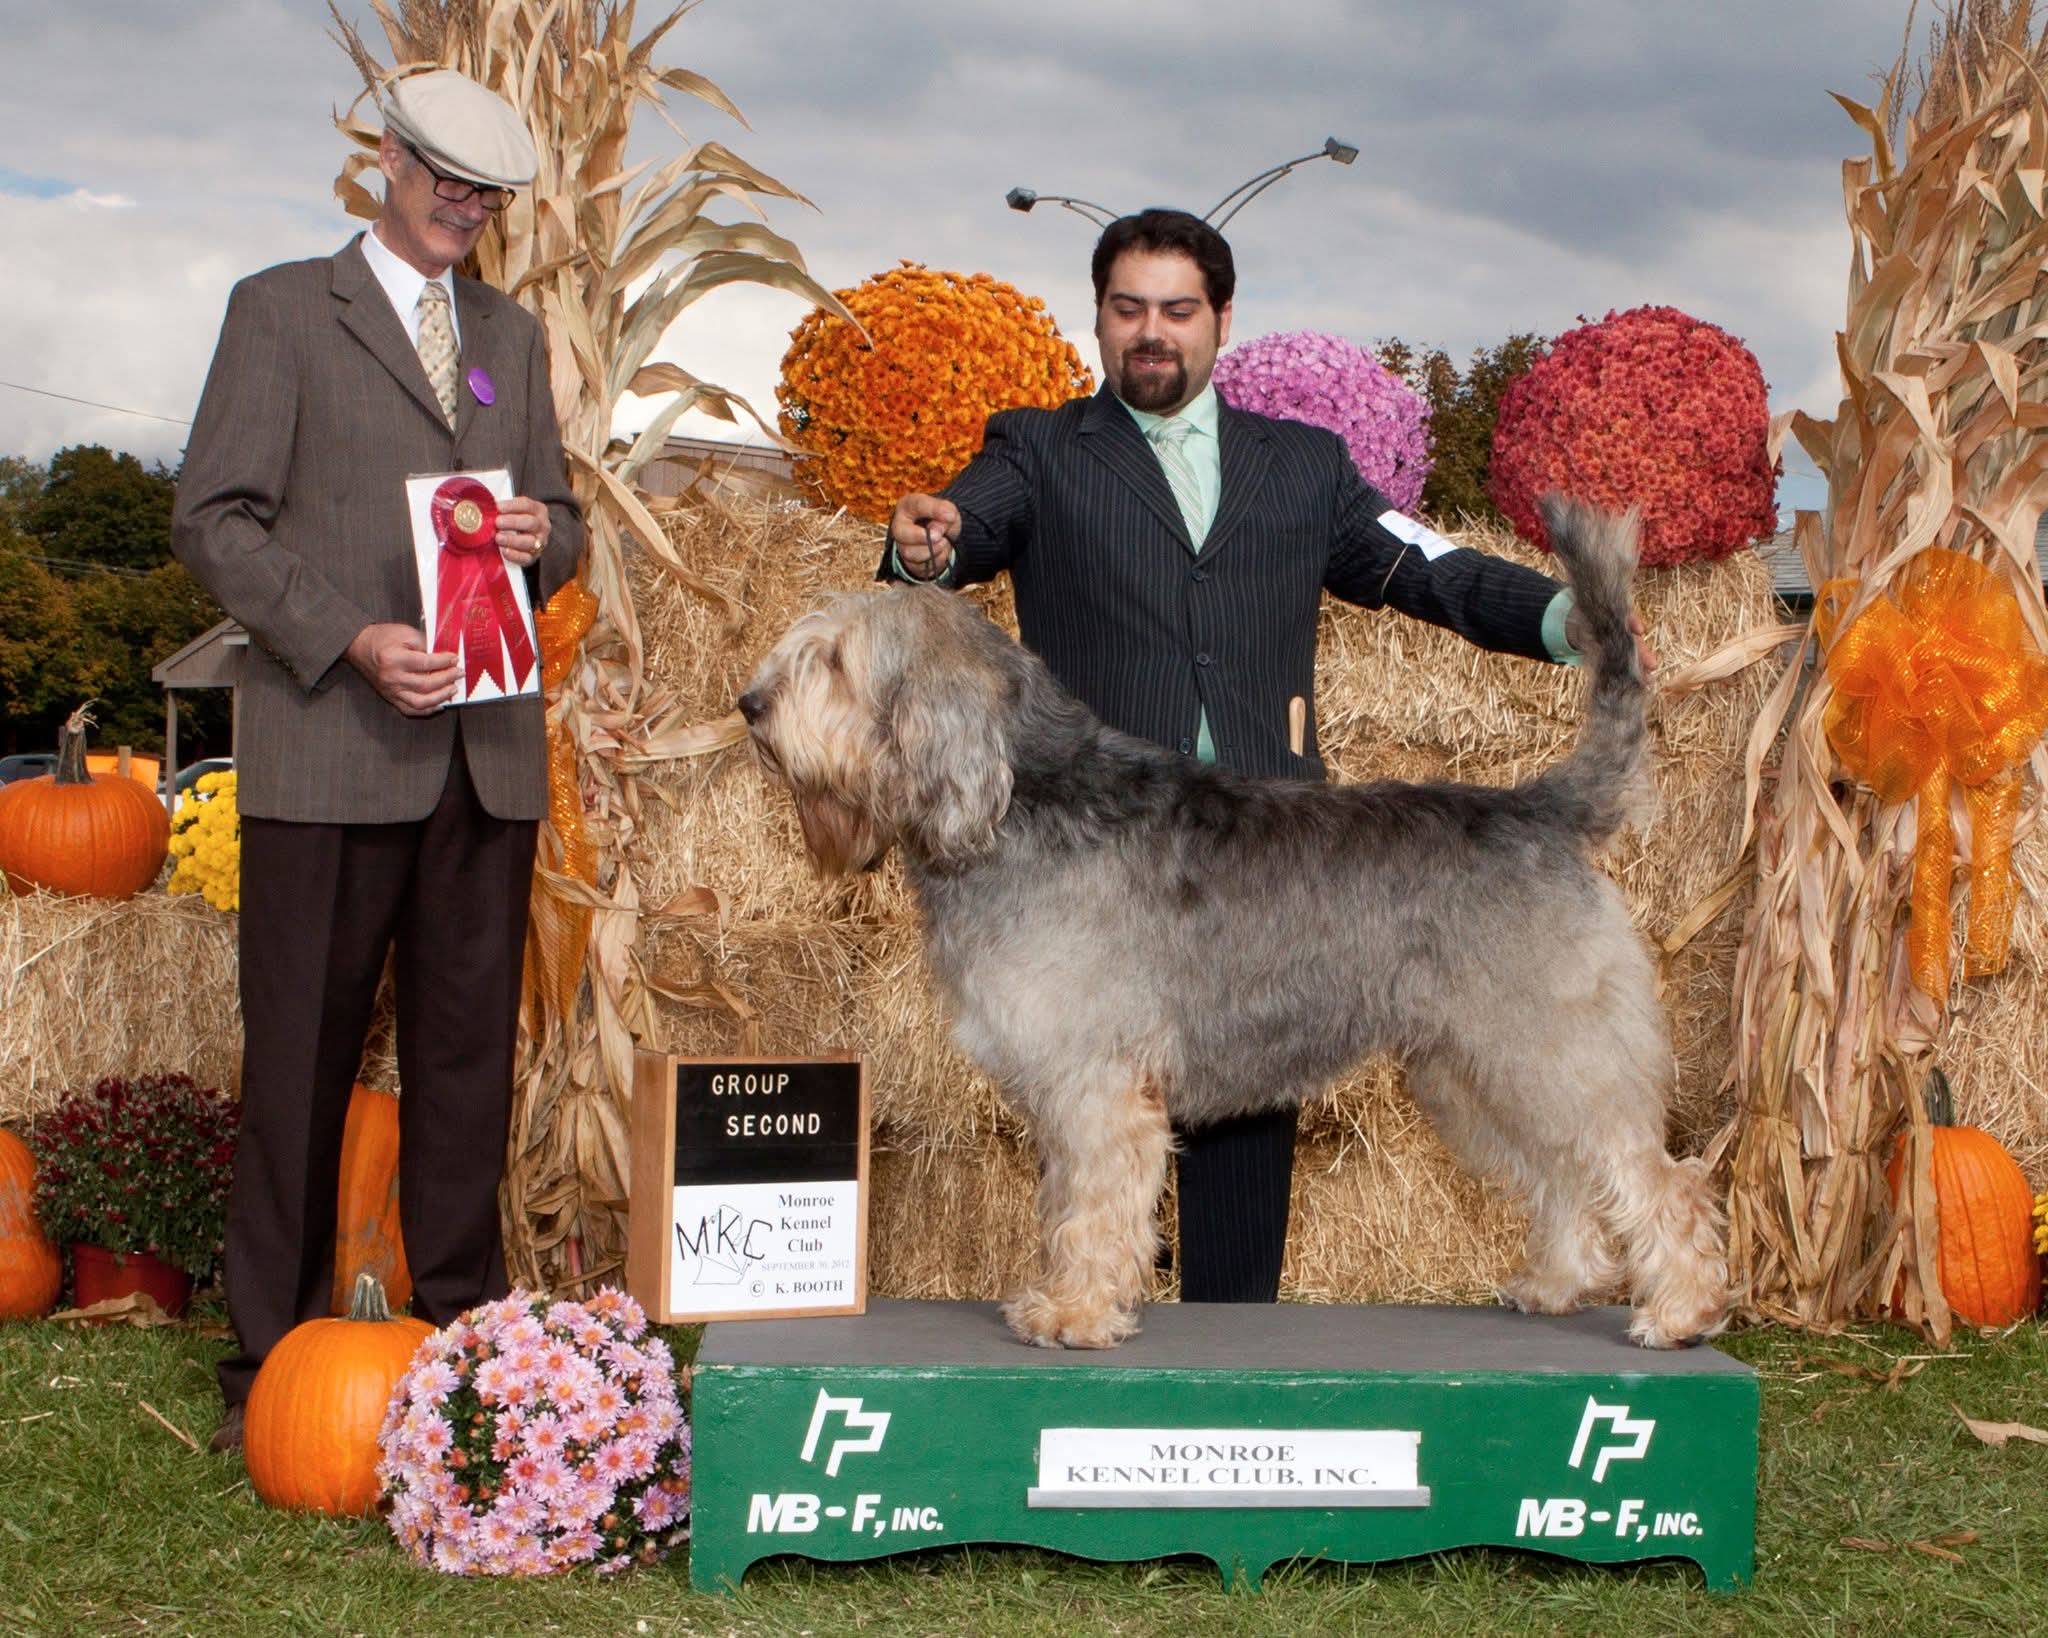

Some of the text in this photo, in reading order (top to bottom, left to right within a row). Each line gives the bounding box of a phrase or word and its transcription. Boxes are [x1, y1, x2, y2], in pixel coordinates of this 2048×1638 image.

[712, 1074, 790, 1095] GROUP
[726, 1113, 821, 1136] SECOND
[778, 1194, 835, 1208] Monroe
[780, 1216, 832, 1231] Kennel
[675, 1208, 773, 1261] MKC
[787, 1238, 823, 1253] Club
[776, 1282, 790, 1294] K.
[793, 1279, 844, 1293] BOOTH
[1150, 1444, 1295, 1462] MONROE
[1066, 1466, 1377, 1487] KENNEL CLUB, INC.
[891, 1507, 944, 1531] INC.
[1653, 1512, 1704, 1536] INC.
